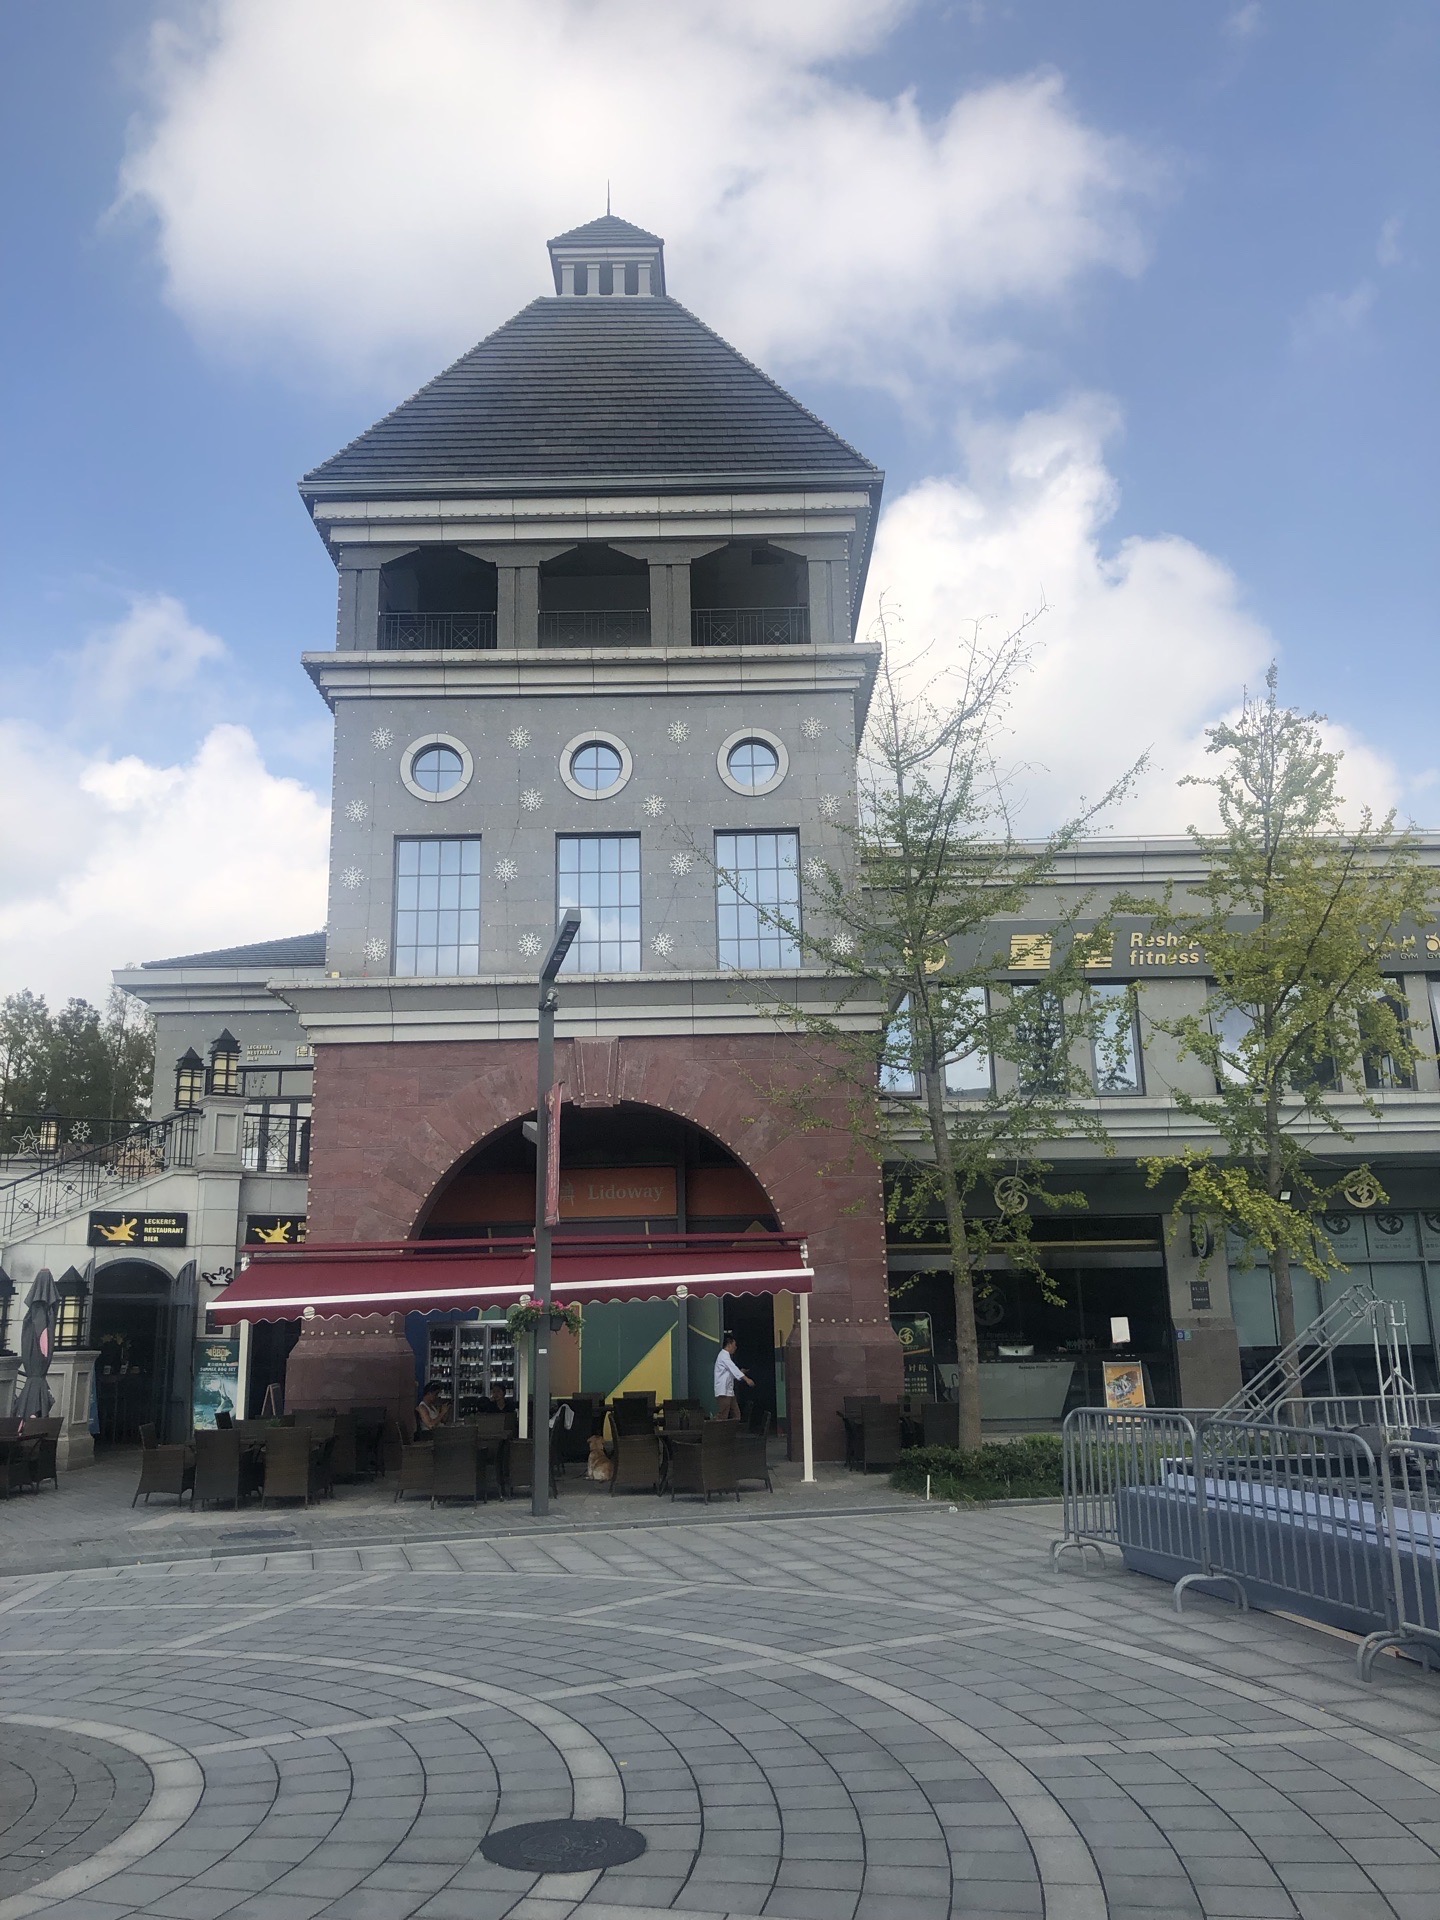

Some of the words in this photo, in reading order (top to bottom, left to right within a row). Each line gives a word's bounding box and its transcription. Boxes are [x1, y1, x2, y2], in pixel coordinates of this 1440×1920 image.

[1130, 950, 1200, 965] fitness
[1400, 952, 1419, 960] GYM
[588, 1184, 664, 1202] Lidoway
